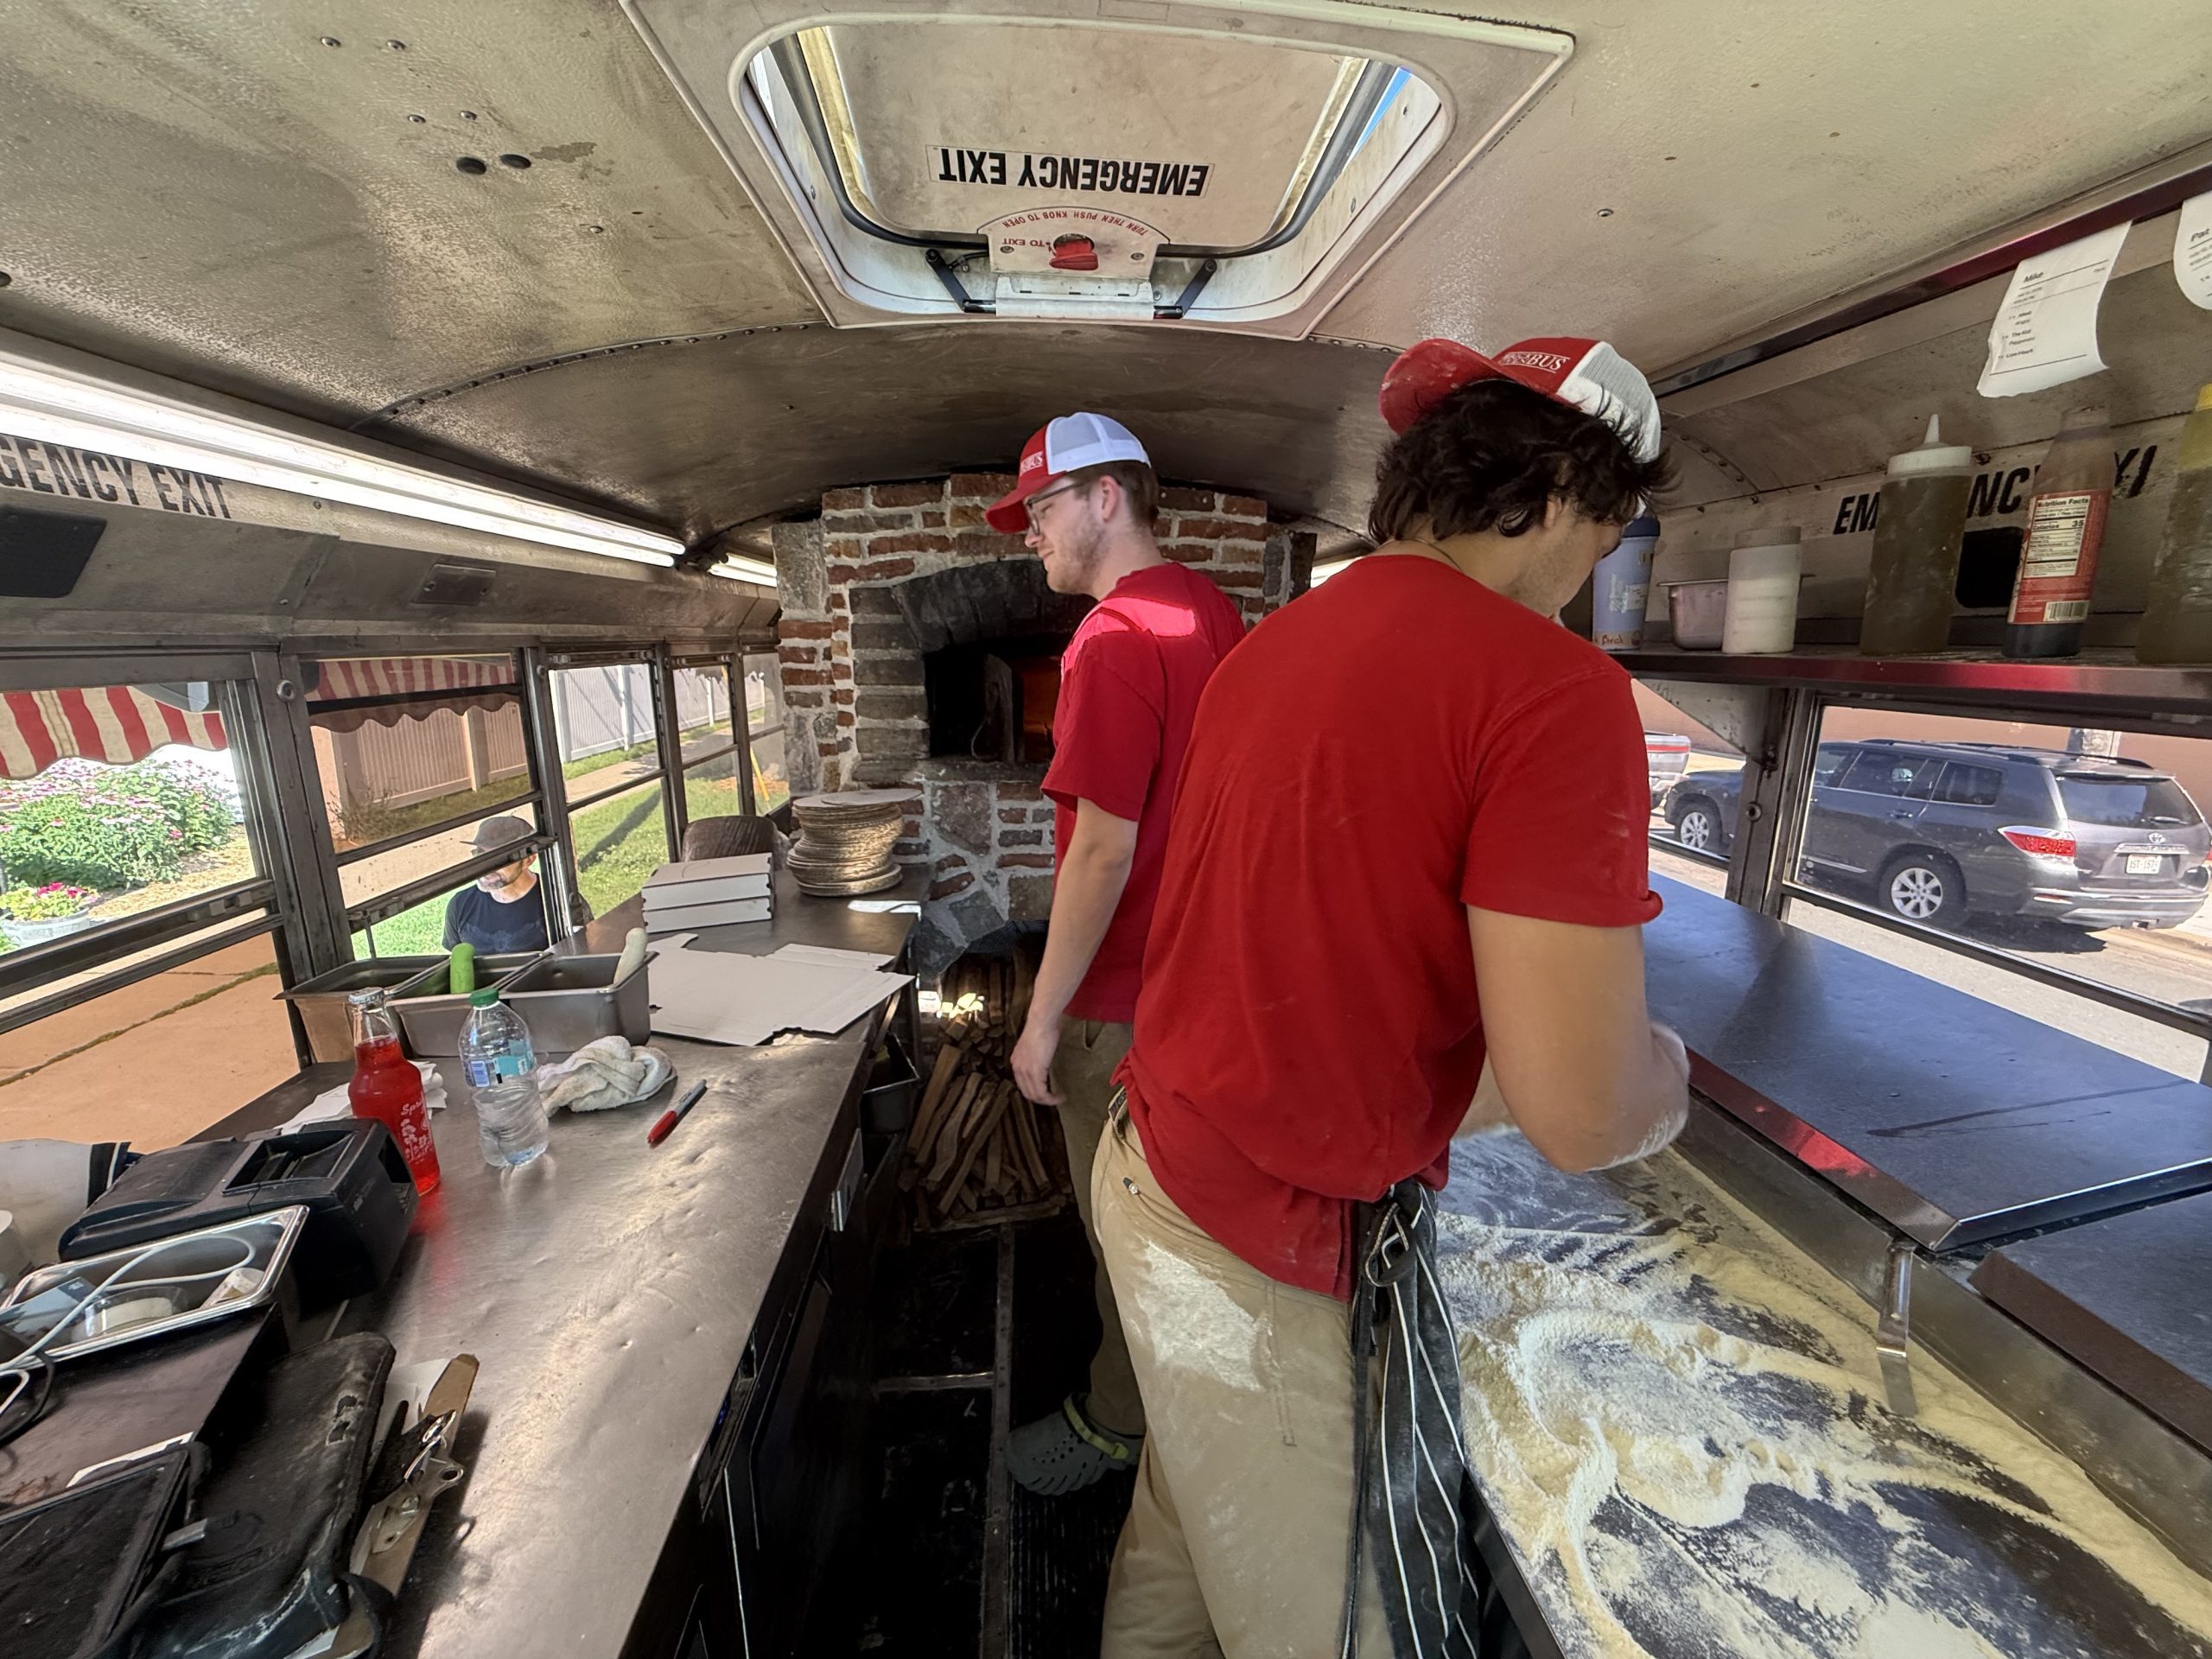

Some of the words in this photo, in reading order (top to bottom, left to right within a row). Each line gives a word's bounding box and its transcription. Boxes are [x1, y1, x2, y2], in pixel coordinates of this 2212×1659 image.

[939, 148, 1007, 185] EXIT
[1018, 155, 1210, 196] EMERGENCY
[1029, 213, 1041, 221] TO
[1042, 211, 1068, 219] KNOB
[1073, 211, 1098, 220] PUSH
[1101, 214, 1125, 226] THEN
[1001, 217, 1027, 229] OPEN
[1126, 222, 1148, 236] TURN
[1001, 238, 1026, 246] EXIT
[147, 463, 232, 519] EXIT
